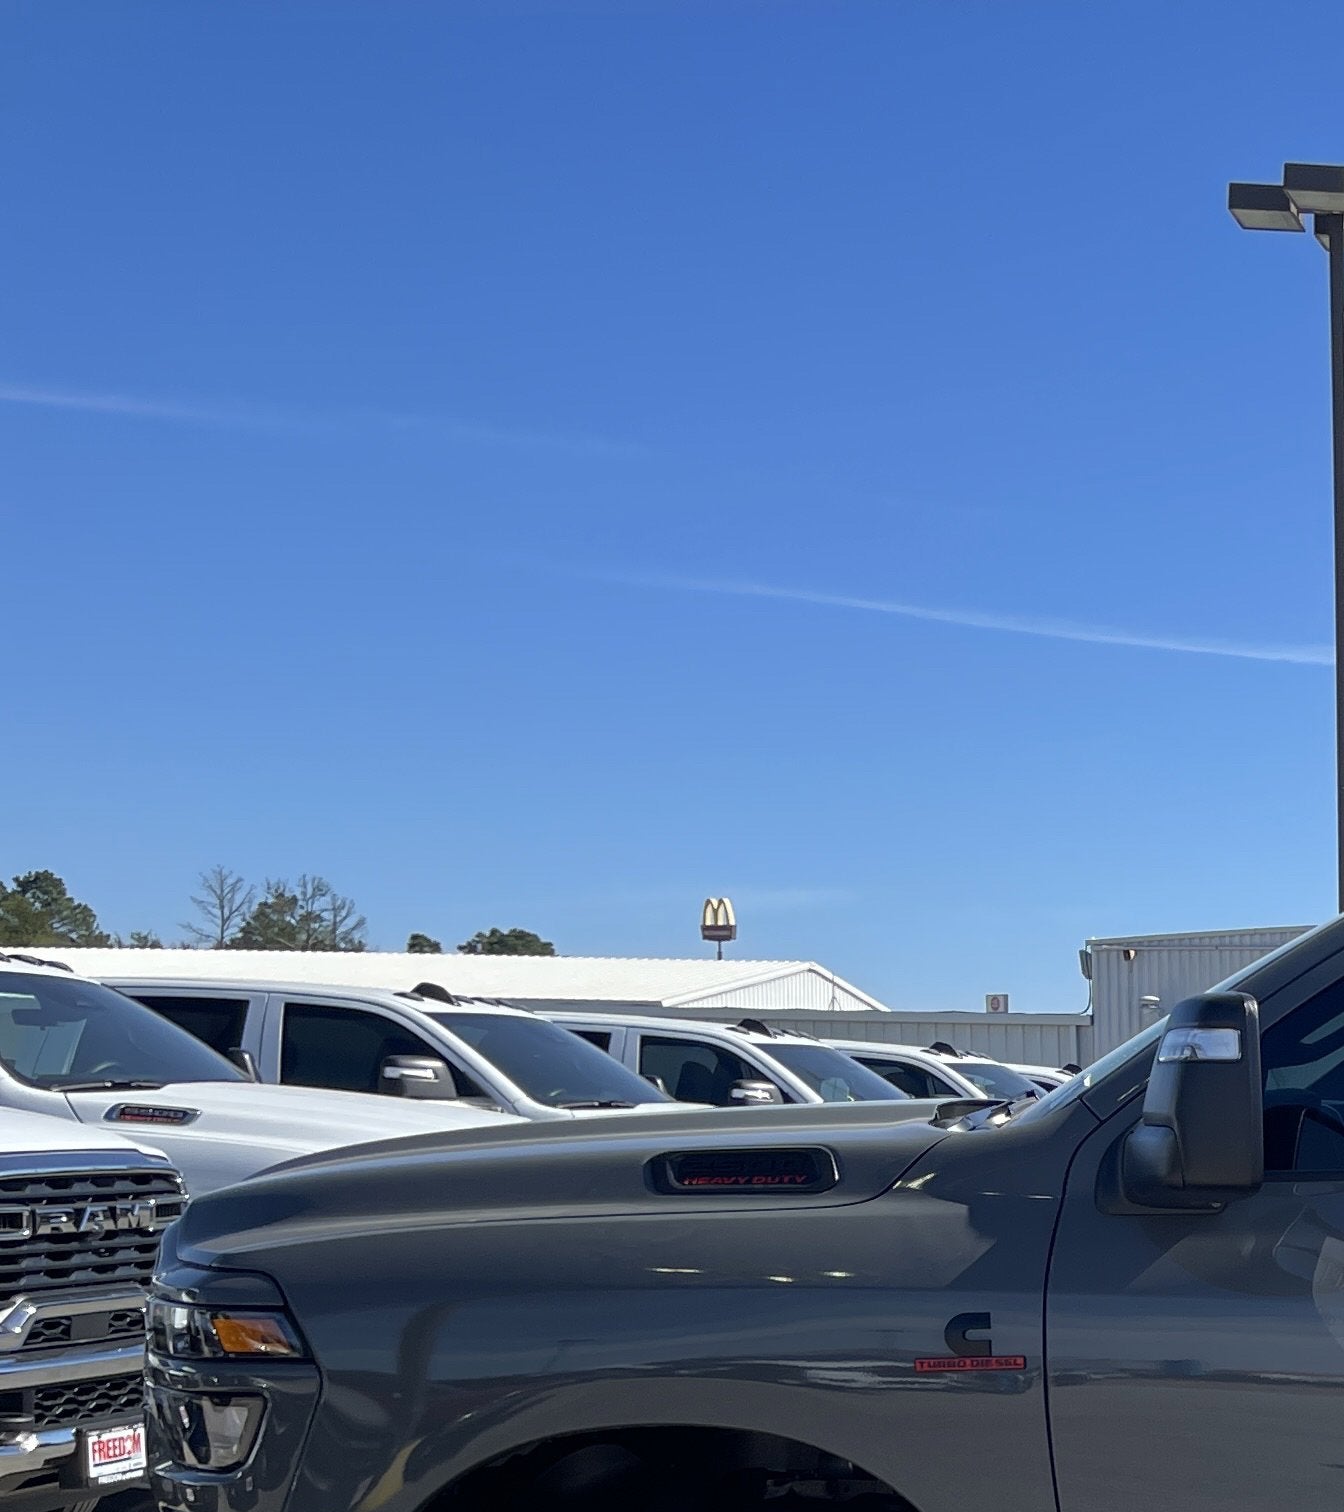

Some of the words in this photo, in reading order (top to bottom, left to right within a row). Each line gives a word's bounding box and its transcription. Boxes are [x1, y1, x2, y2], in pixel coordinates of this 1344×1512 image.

[683, 1176, 748, 1186] HEAVY
[751, 1174, 808, 1185] DUTY
[35, 1204, 152, 1235] RAM
[918, 1360, 967, 1369] TURBO
